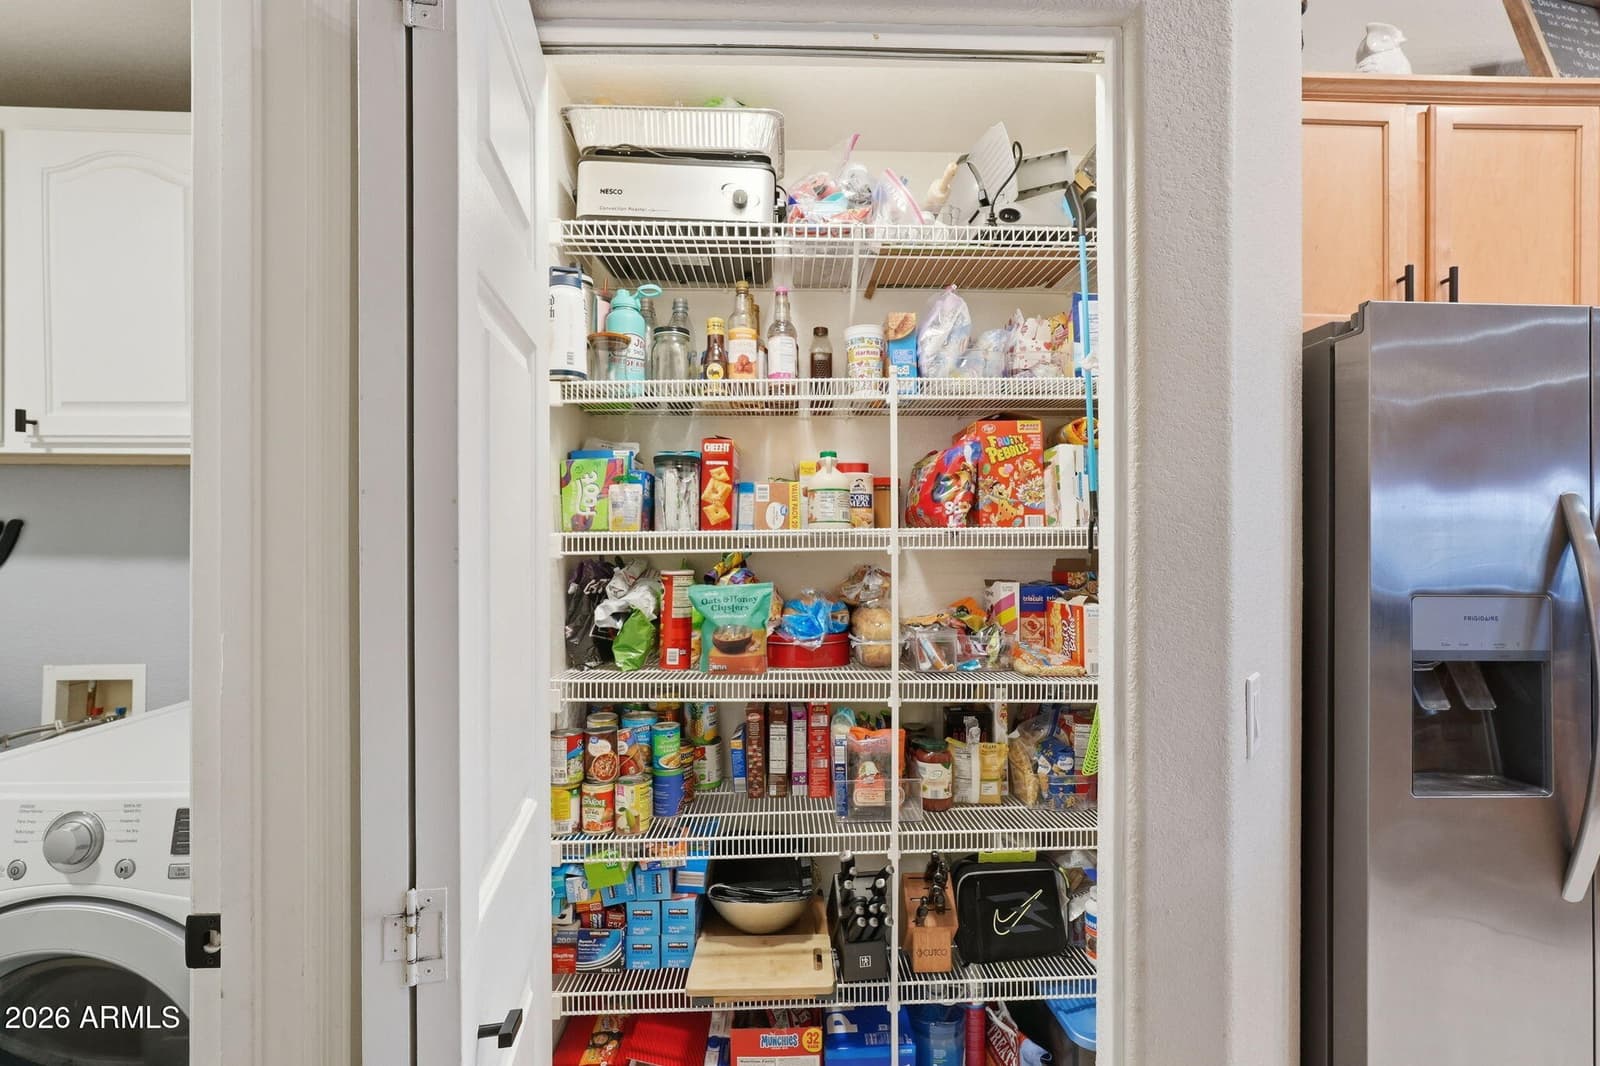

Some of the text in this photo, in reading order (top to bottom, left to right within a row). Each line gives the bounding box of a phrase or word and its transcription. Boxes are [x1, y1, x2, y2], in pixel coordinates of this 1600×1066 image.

[985, 443, 1029, 465] PEBBLES
[729, 595, 758, 604] Honey
[711, 603, 749, 614] Clusters
[923, 948, 948, 957] CUTCO
[760, 1034, 798, 1049] MUNCHIES
[806, 1032, 819, 1045] 32
